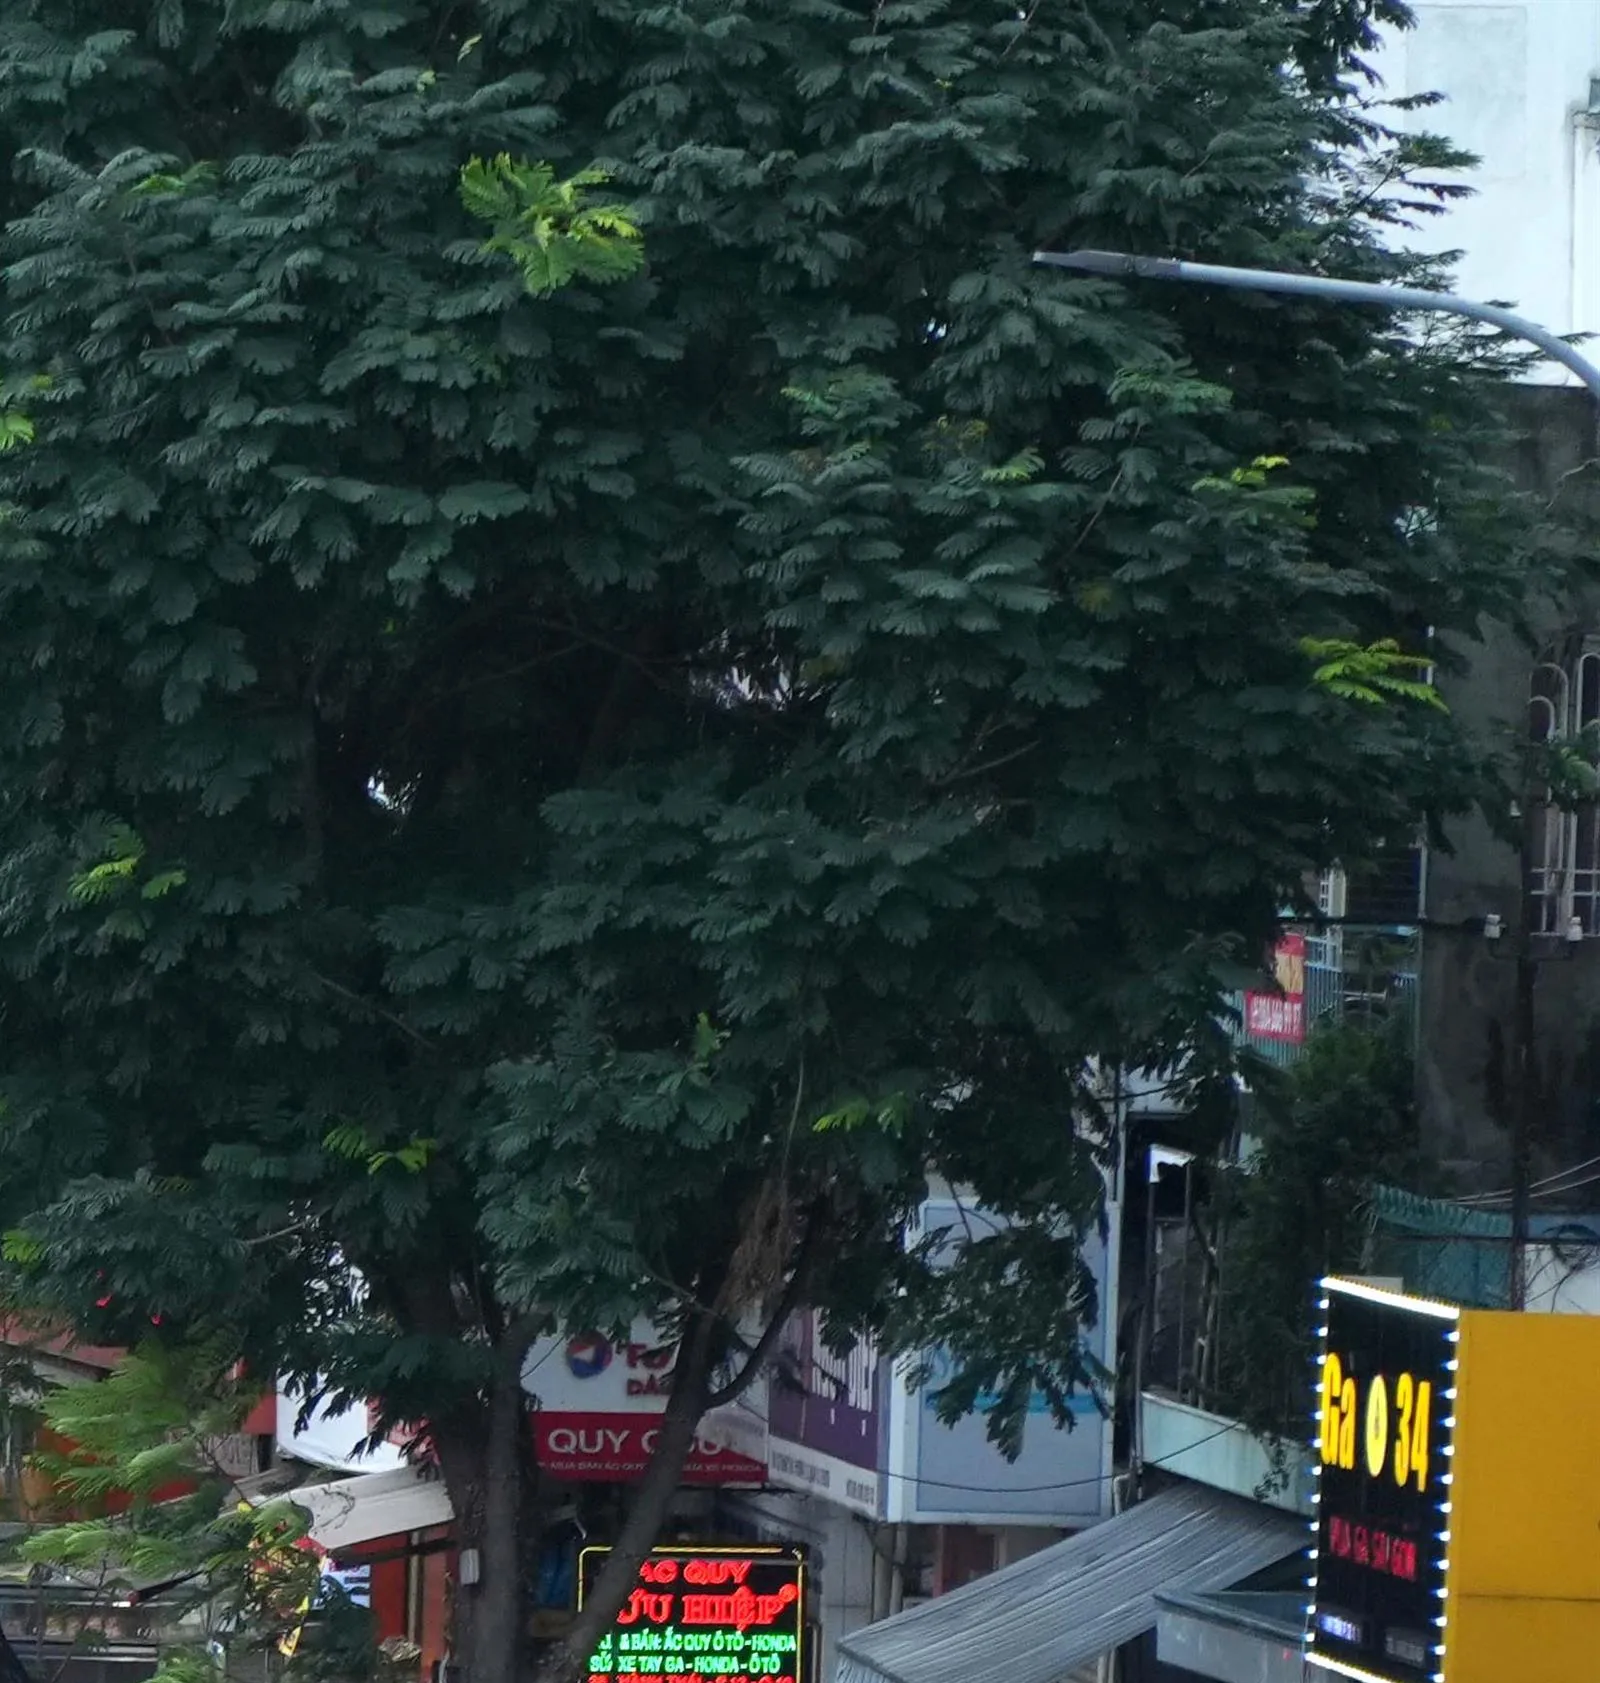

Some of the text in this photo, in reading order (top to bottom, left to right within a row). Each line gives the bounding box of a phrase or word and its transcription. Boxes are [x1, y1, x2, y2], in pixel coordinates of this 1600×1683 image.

[547, 1428, 629, 1456] QUY
[1394, 1372, 1431, 1493] 34
[683, 1560, 752, 1585] QUY
[751, 1633, 797, 1652] HONDA
[693, 1655, 740, 1674] HONDA
